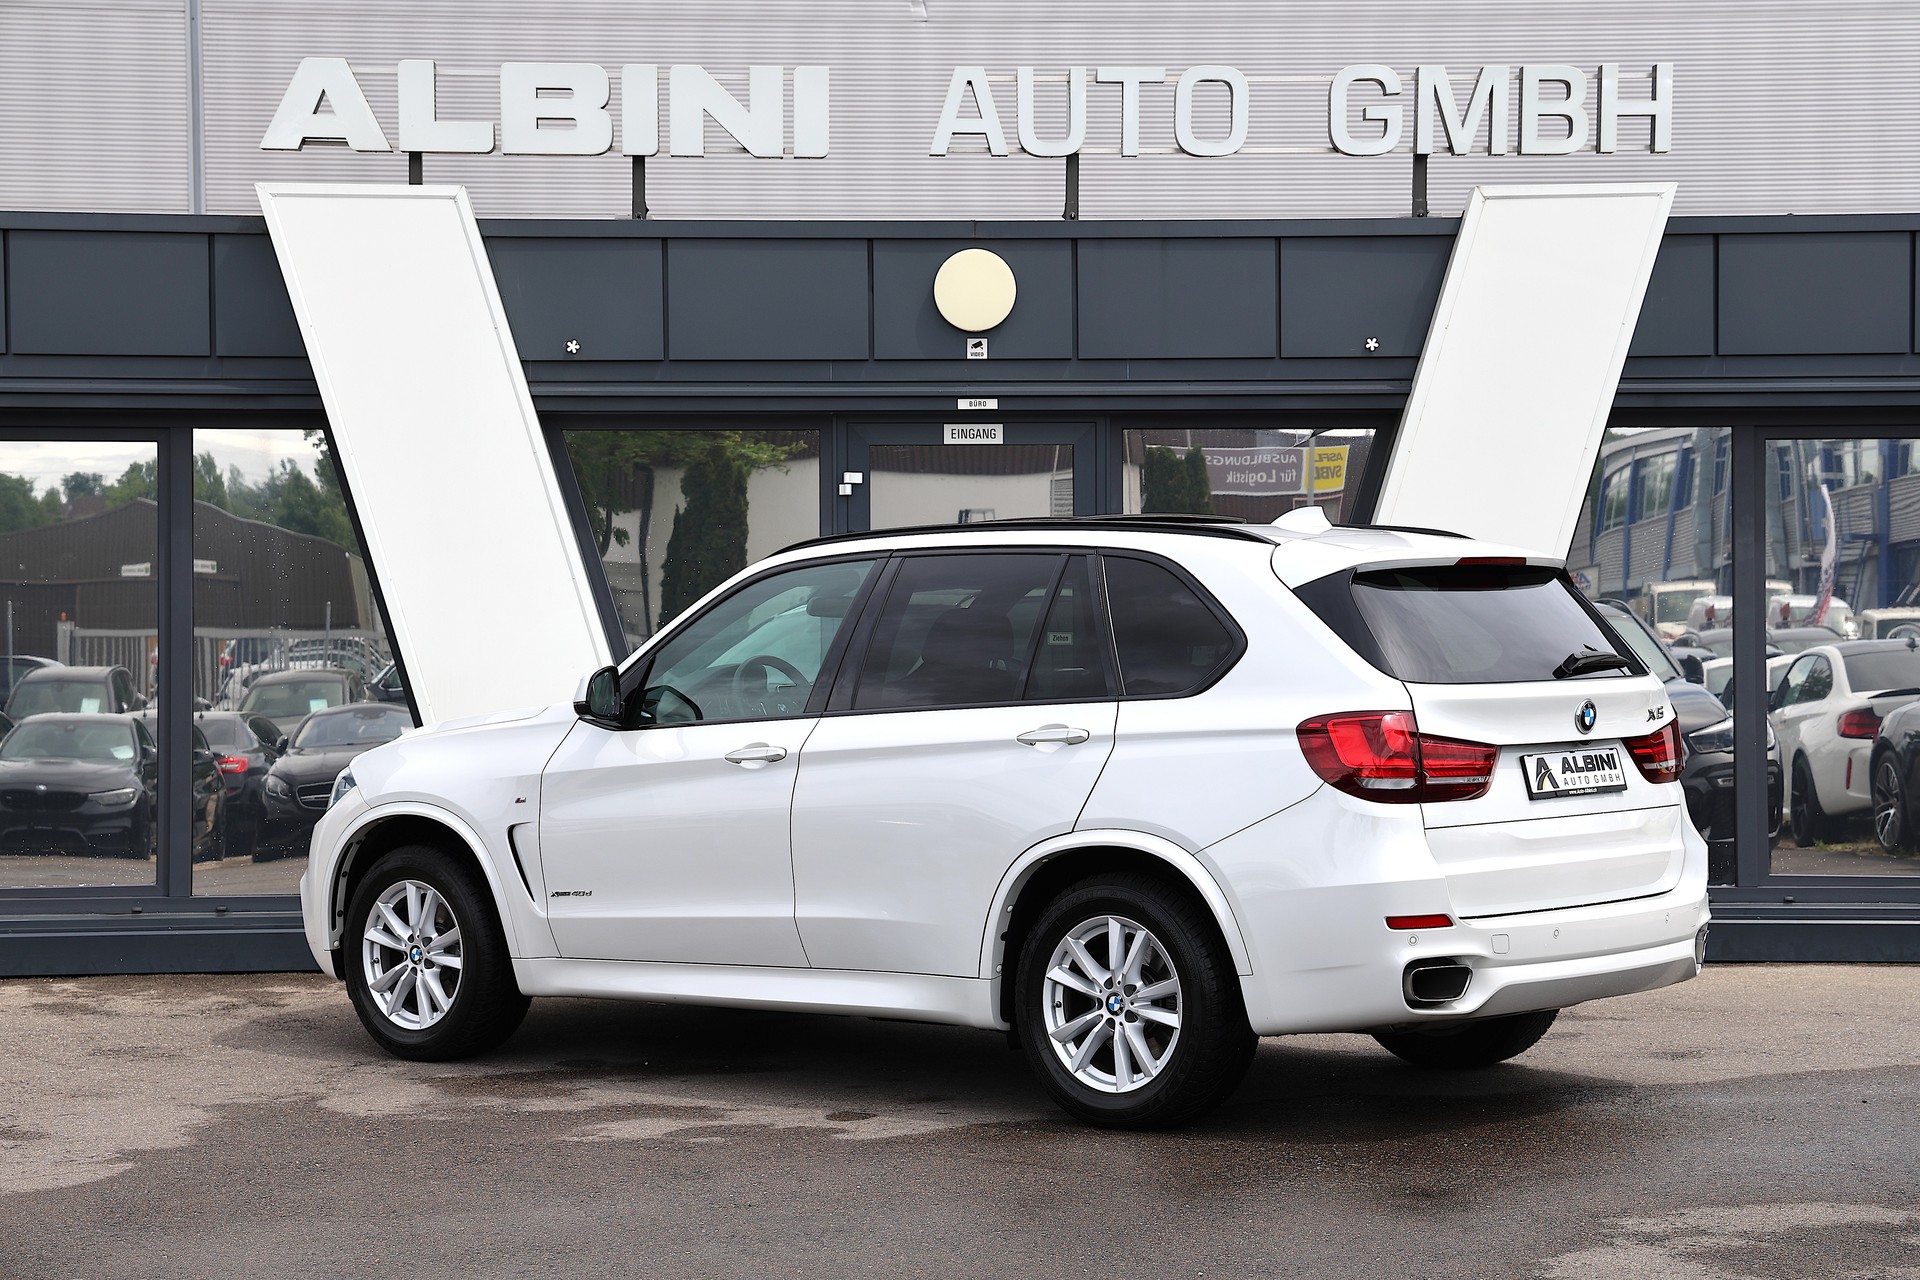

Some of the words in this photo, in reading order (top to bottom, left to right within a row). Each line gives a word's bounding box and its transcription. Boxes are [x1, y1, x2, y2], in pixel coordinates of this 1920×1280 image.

[259, 57, 830, 158] ALBINI
[929, 64, 1249, 158] AUTO
[1328, 62, 1674, 156] GMBH
[951, 428, 997, 439] EINGANG
[1646, 706, 1664, 722] X5
[1561, 753, 1617, 775] ALBINI
[1564, 775, 1590, 786] AUTO
[1593, 772, 1621, 784] GMBH
